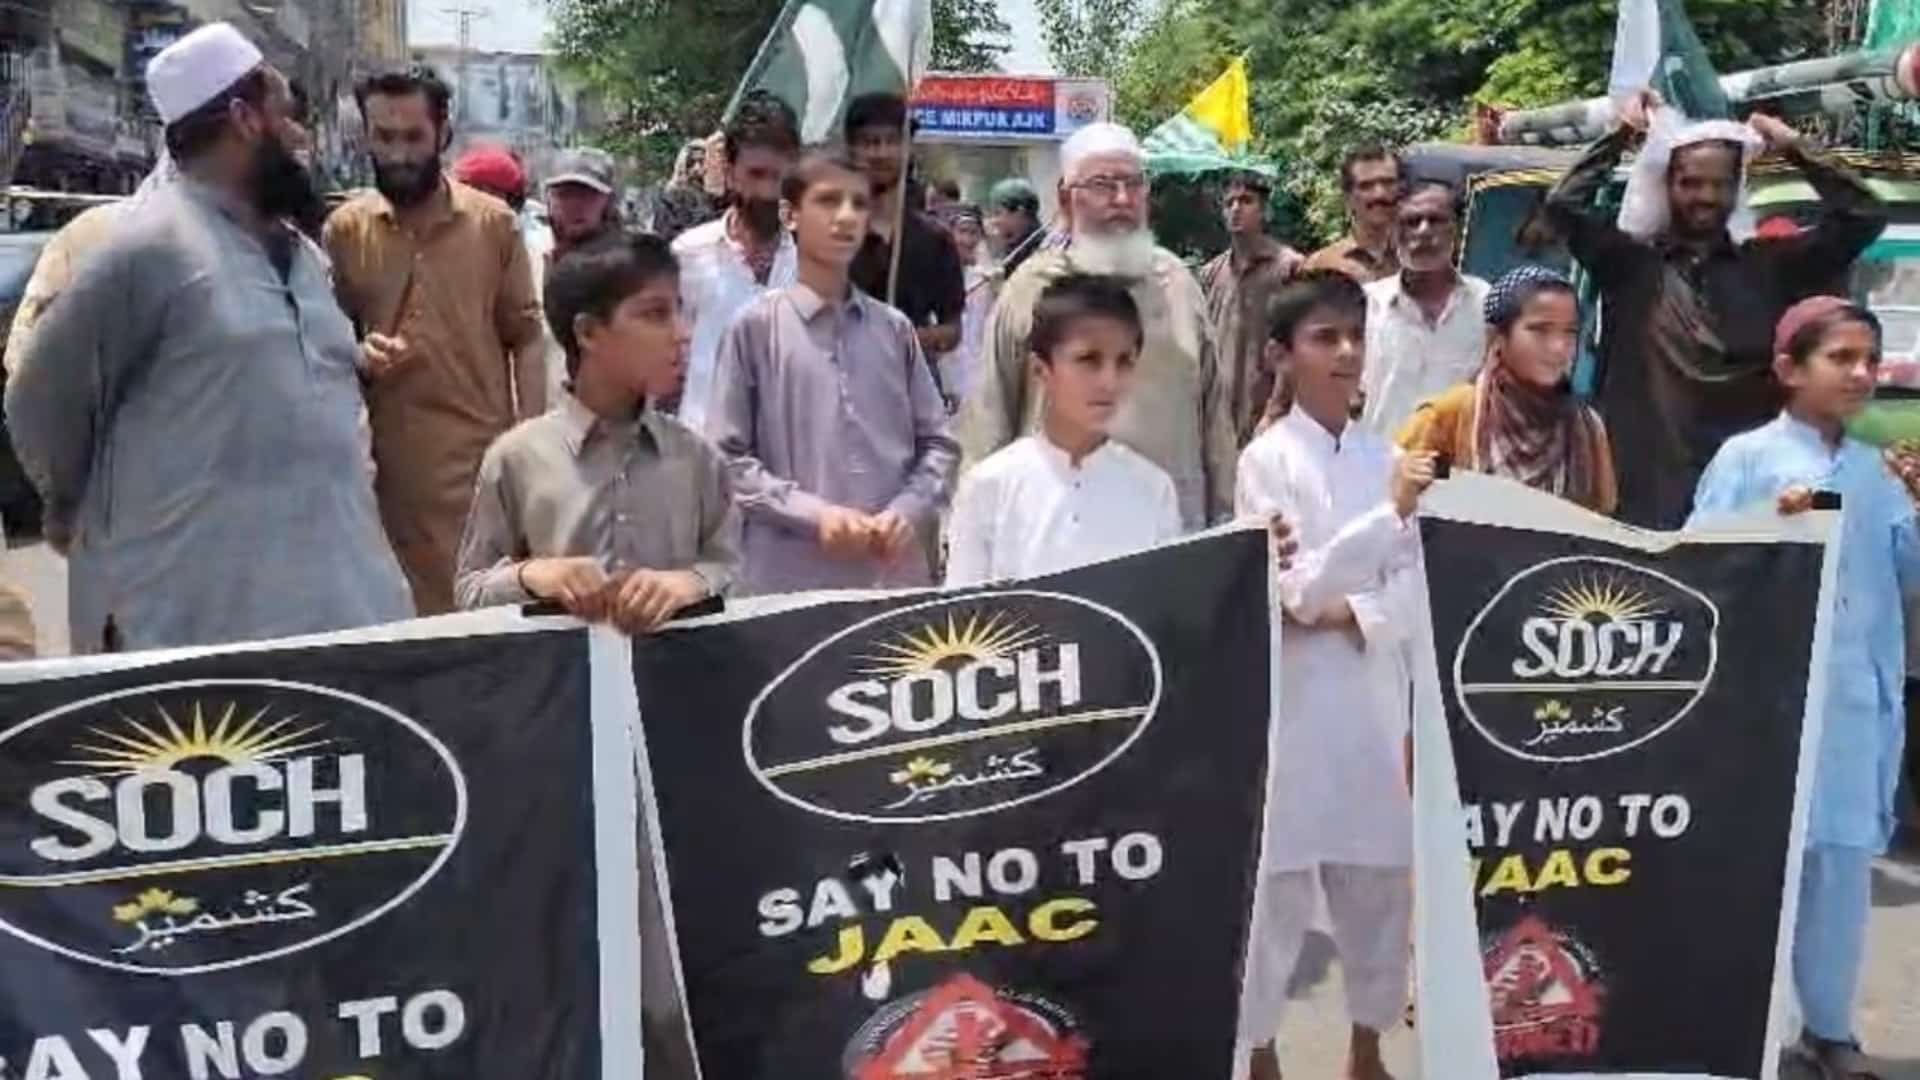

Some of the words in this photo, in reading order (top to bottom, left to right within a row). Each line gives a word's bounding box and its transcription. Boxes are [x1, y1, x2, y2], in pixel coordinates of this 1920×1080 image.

[1513, 618, 1683, 678] SOCH
[826, 642, 1081, 744] SOCH
[1524, 704, 1627, 747] کشمیر
[30, 754, 367, 861] SOCH
[882, 748, 1047, 809] کشمیر
[1463, 801, 1526, 847] AY
[1533, 795, 1603, 842] NO
[1618, 794, 1691, 838] TO
[110, 882, 317, 954] کشمیر
[756, 864, 900, 937] SAY
[932, 848, 1038, 902] NO
[1061, 832, 1163, 885] TO
[808, 897, 1099, 975] JAAC
[0, 1026, 150, 1080] AY
[181, 1011, 307, 1080] NO
[339, 989, 465, 1059] TO
